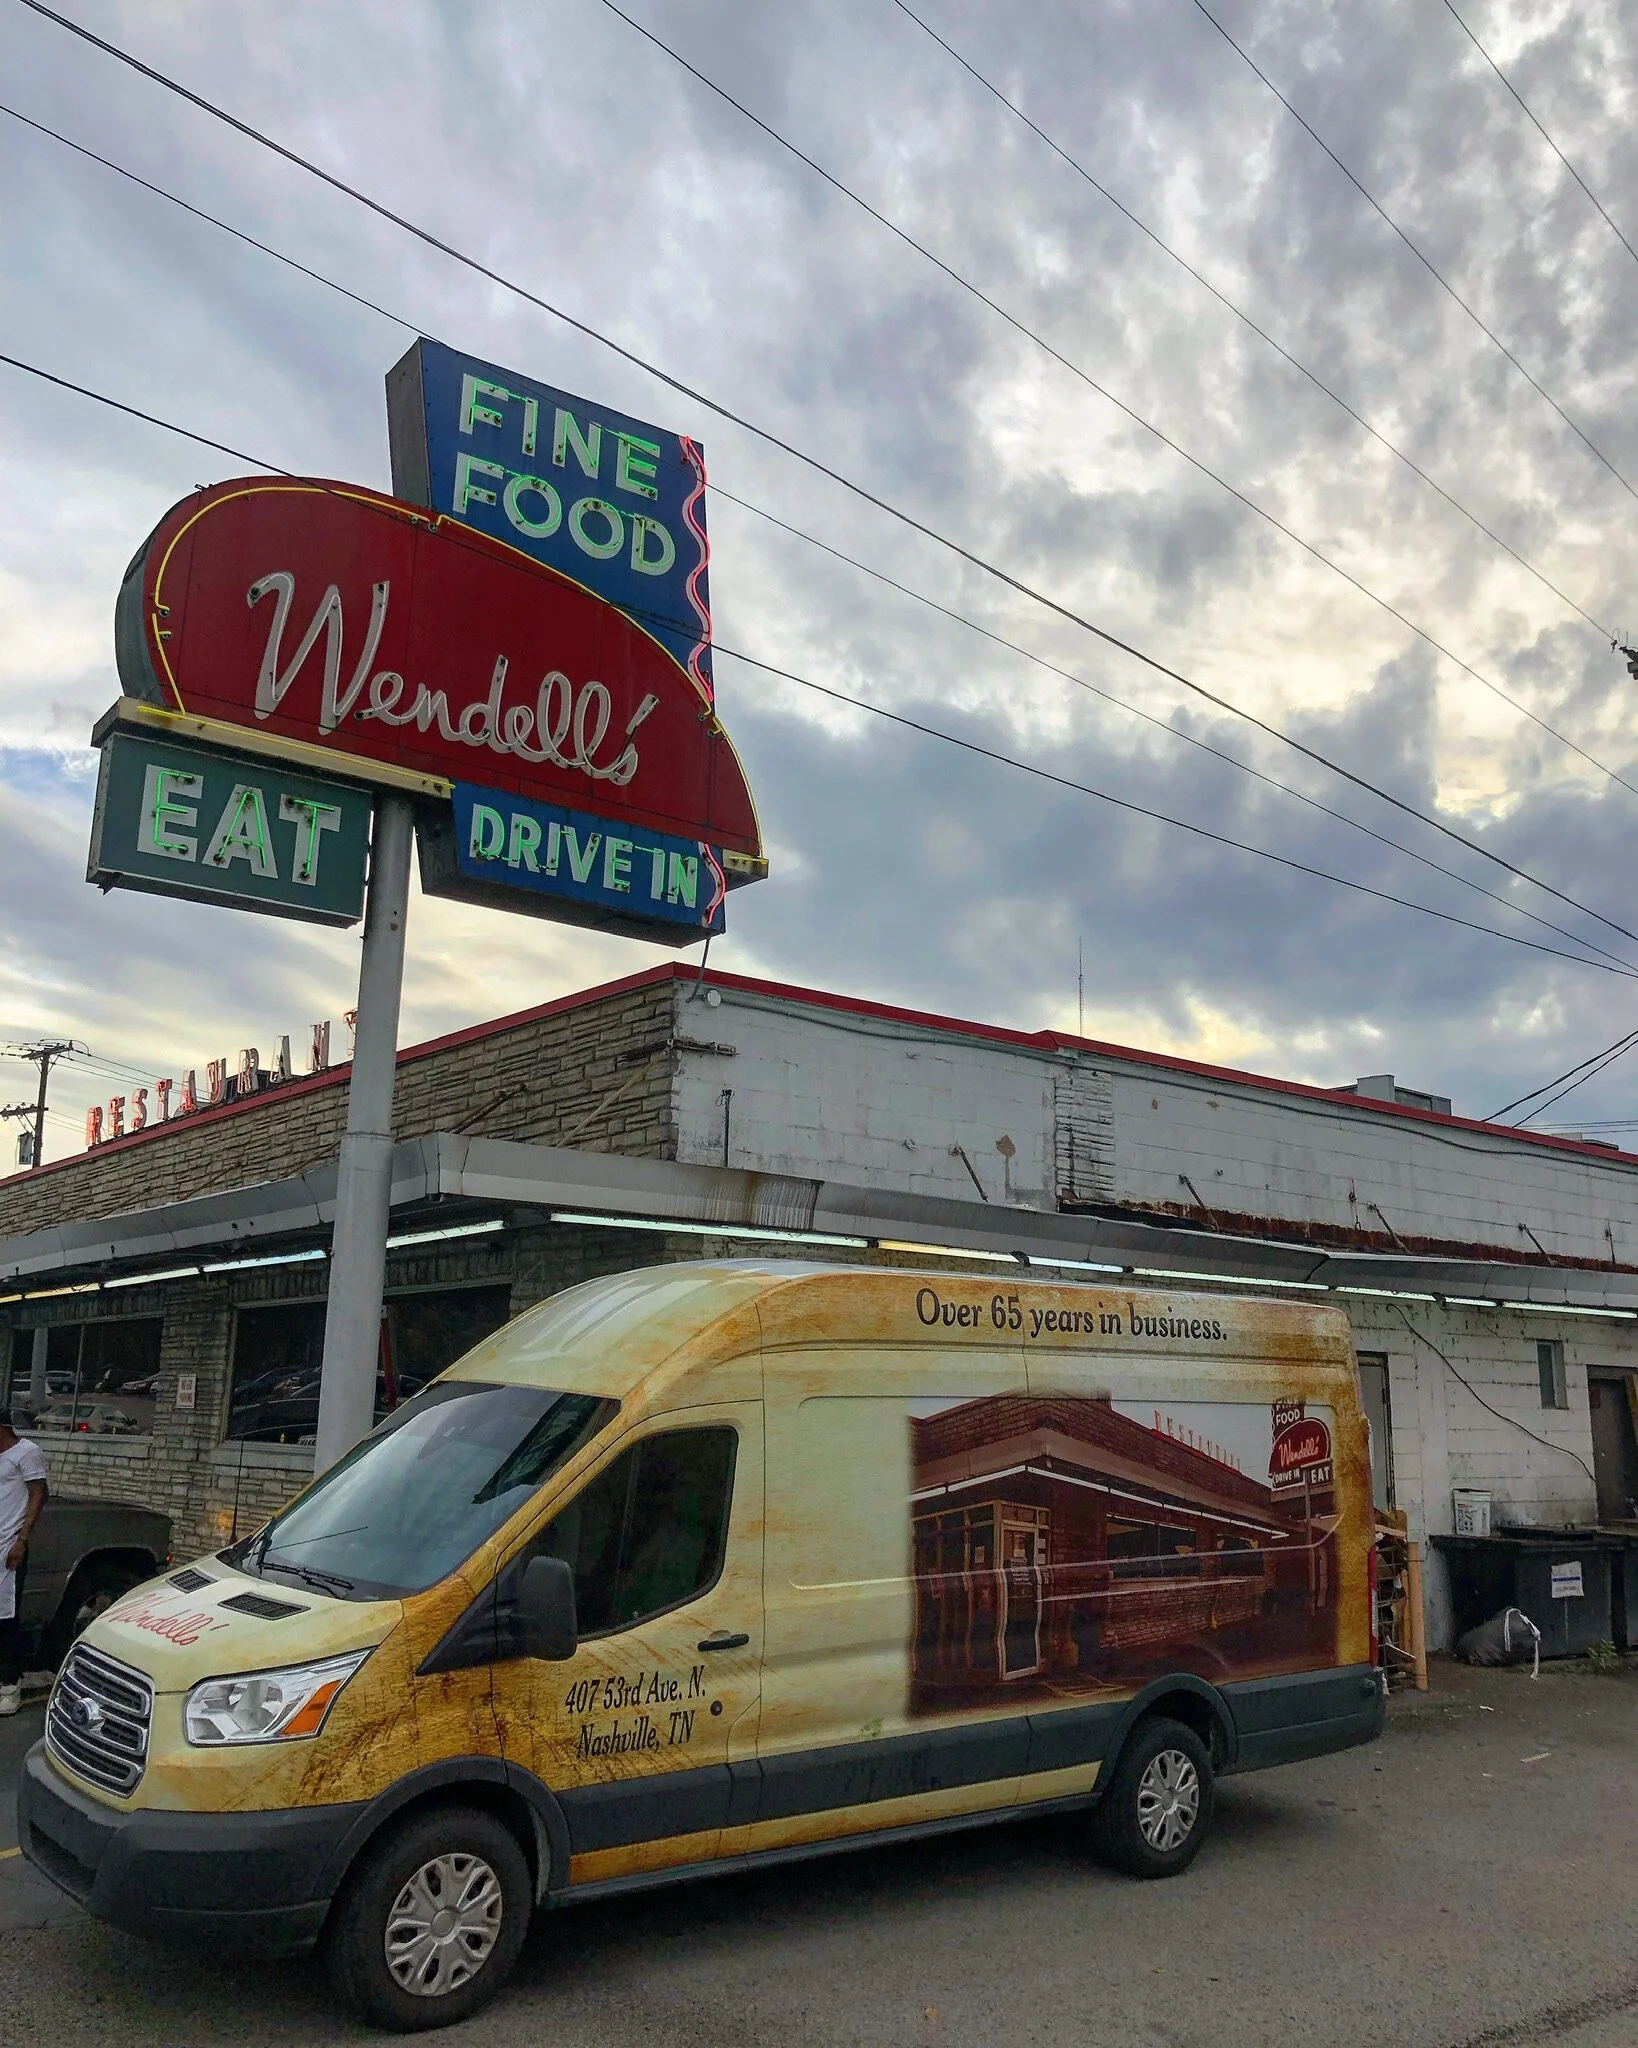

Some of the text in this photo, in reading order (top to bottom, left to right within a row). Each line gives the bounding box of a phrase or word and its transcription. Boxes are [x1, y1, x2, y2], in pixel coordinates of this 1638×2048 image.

[459, 373, 661, 500] FINE
[453, 452, 676, 576] FOOD
[247, 571, 659, 786] Wendell's
[136, 763, 342, 887] EAT
[469, 803, 698, 909] DRIVE IN
[85, 1009, 358, 1147] RESTAURANT
[916, 1287, 1228, 1341] Over 65 years in business.
[1275, 1408, 1301, 1427] FOOD
[1310, 1466, 1330, 1484] EAT
[564, 1664, 706, 1715] 407 53rd Ave. N.
[576, 1710, 695, 1760] Nashville, TN
